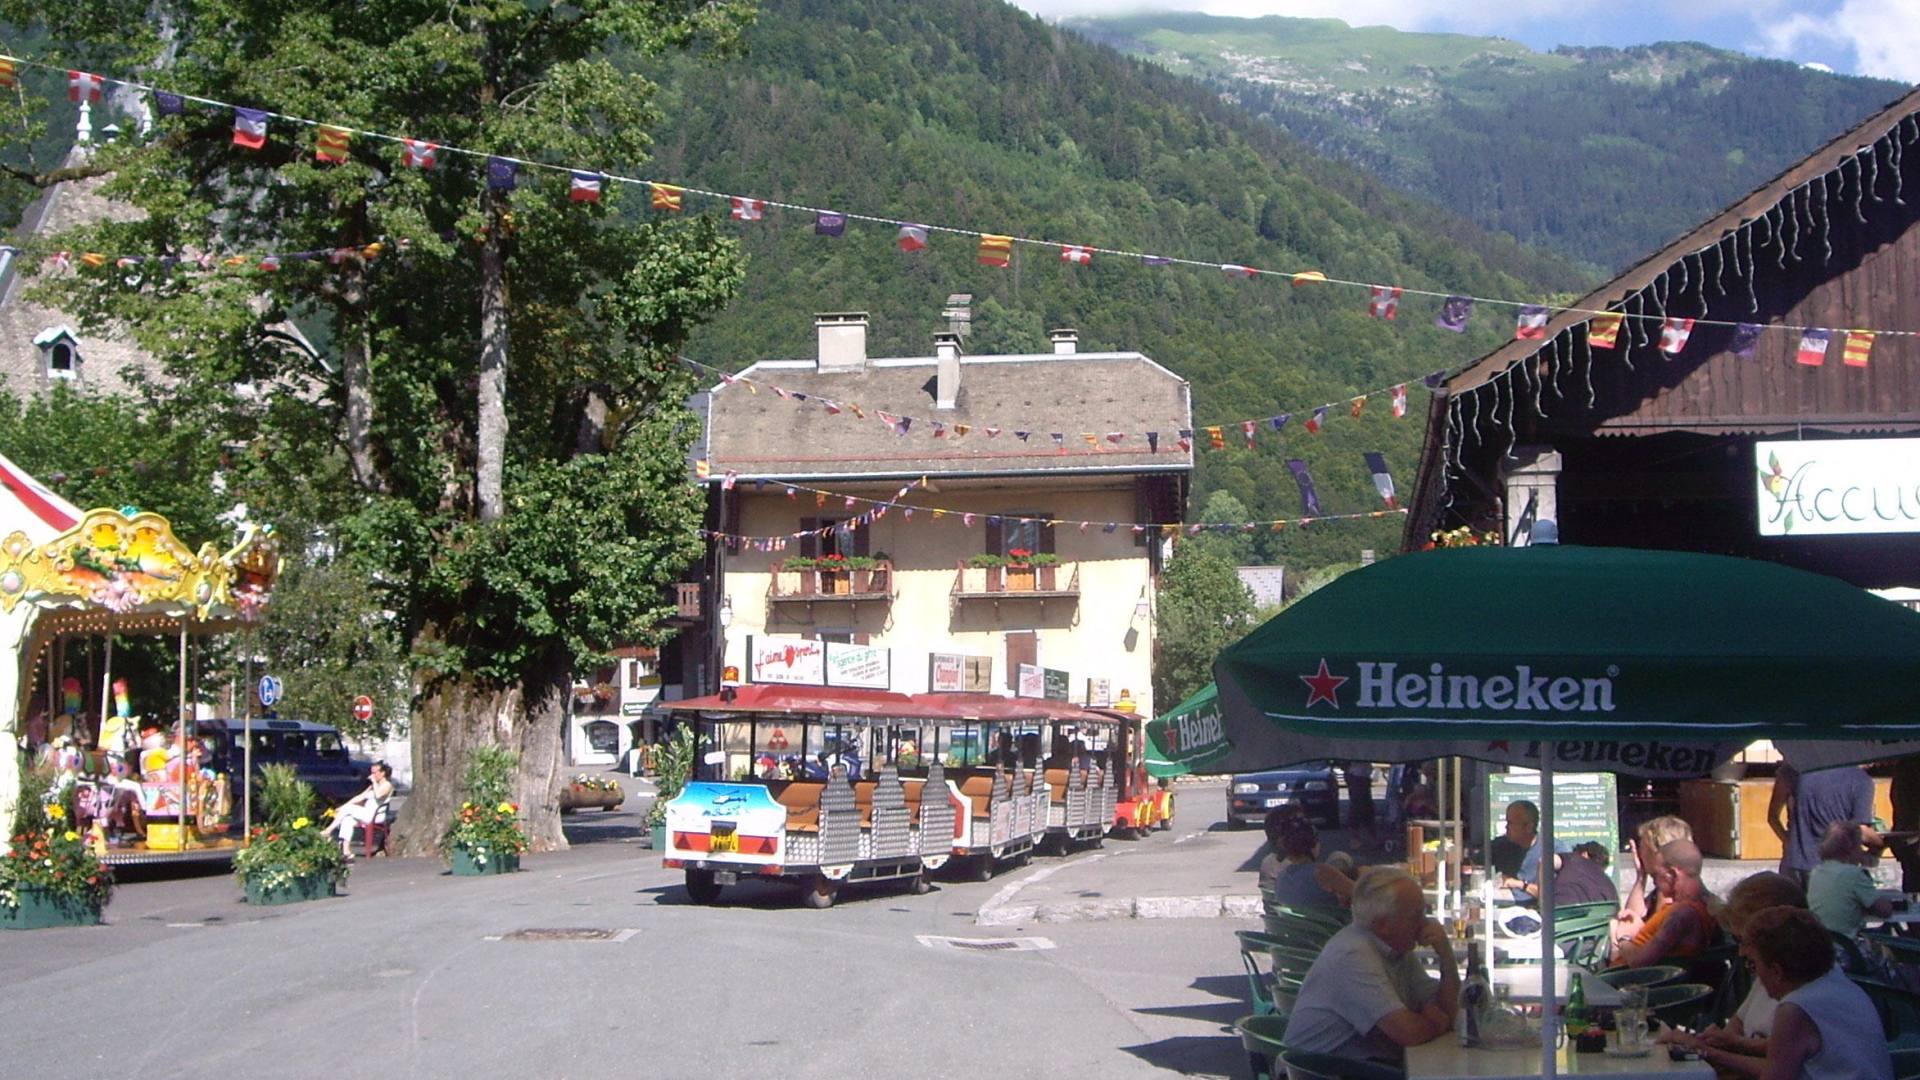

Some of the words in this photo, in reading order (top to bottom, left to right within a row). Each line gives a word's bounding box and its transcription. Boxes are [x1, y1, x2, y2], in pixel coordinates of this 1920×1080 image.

[1768, 460, 1920, 523] Accu
[1356, 662, 1616, 711] Heineken
[1525, 741, 1716, 772] eineken
